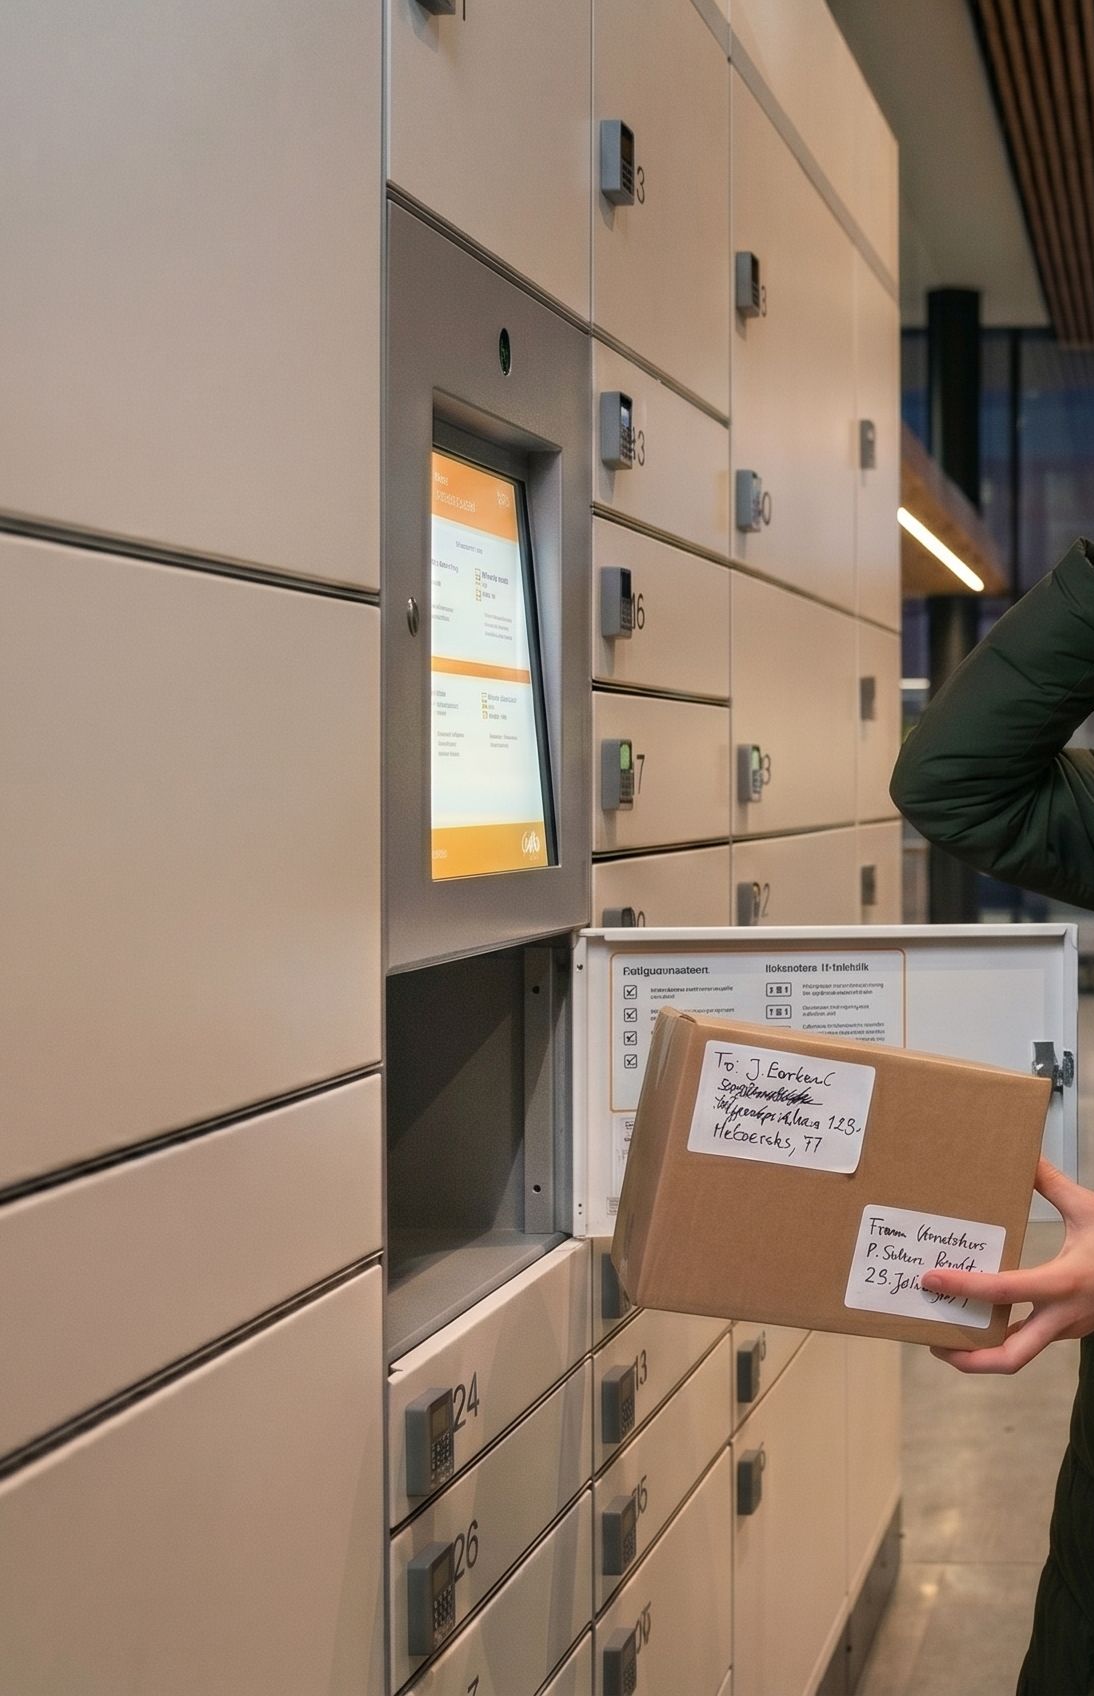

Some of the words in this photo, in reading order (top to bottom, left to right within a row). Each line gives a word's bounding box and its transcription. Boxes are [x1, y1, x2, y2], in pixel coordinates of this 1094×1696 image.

[714, 1051, 739, 1074] To:
[453, 1370, 480, 1434] 24
[453, 1519, 480, 1585] 26
